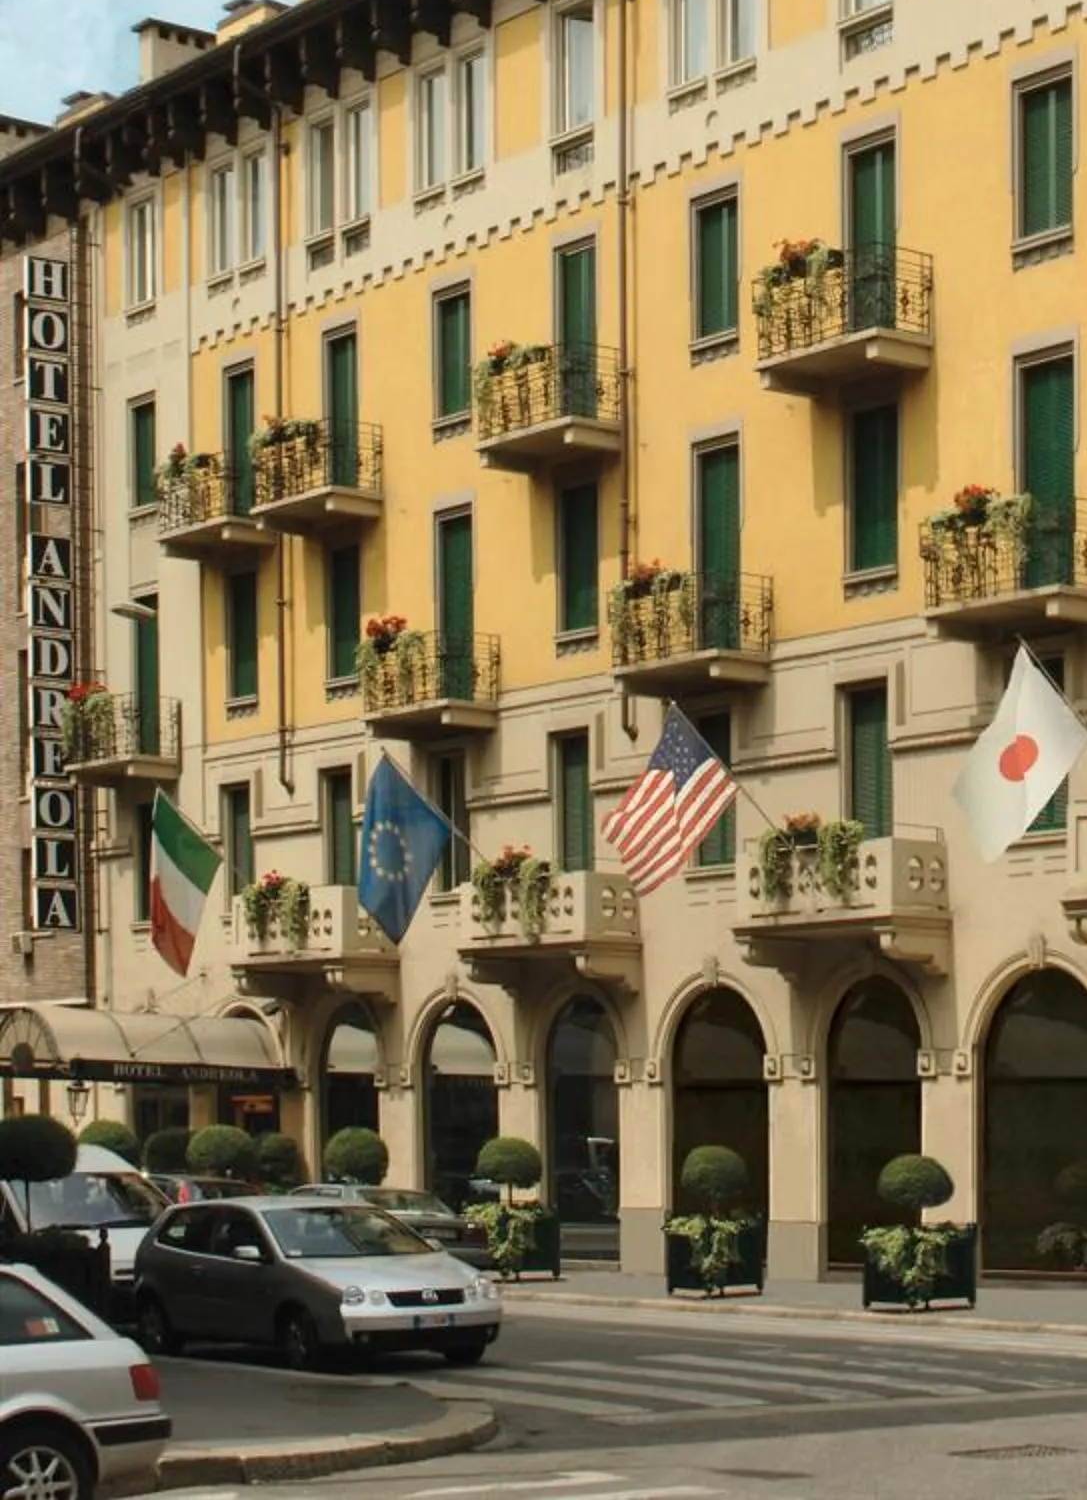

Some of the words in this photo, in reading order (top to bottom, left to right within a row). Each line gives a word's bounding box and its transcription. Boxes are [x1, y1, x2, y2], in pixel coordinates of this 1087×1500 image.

[32, 259, 66, 501] HOTEL
[36, 539, 73, 927] ANDREOLA
[112, 1063, 163, 1077] HOTEL
